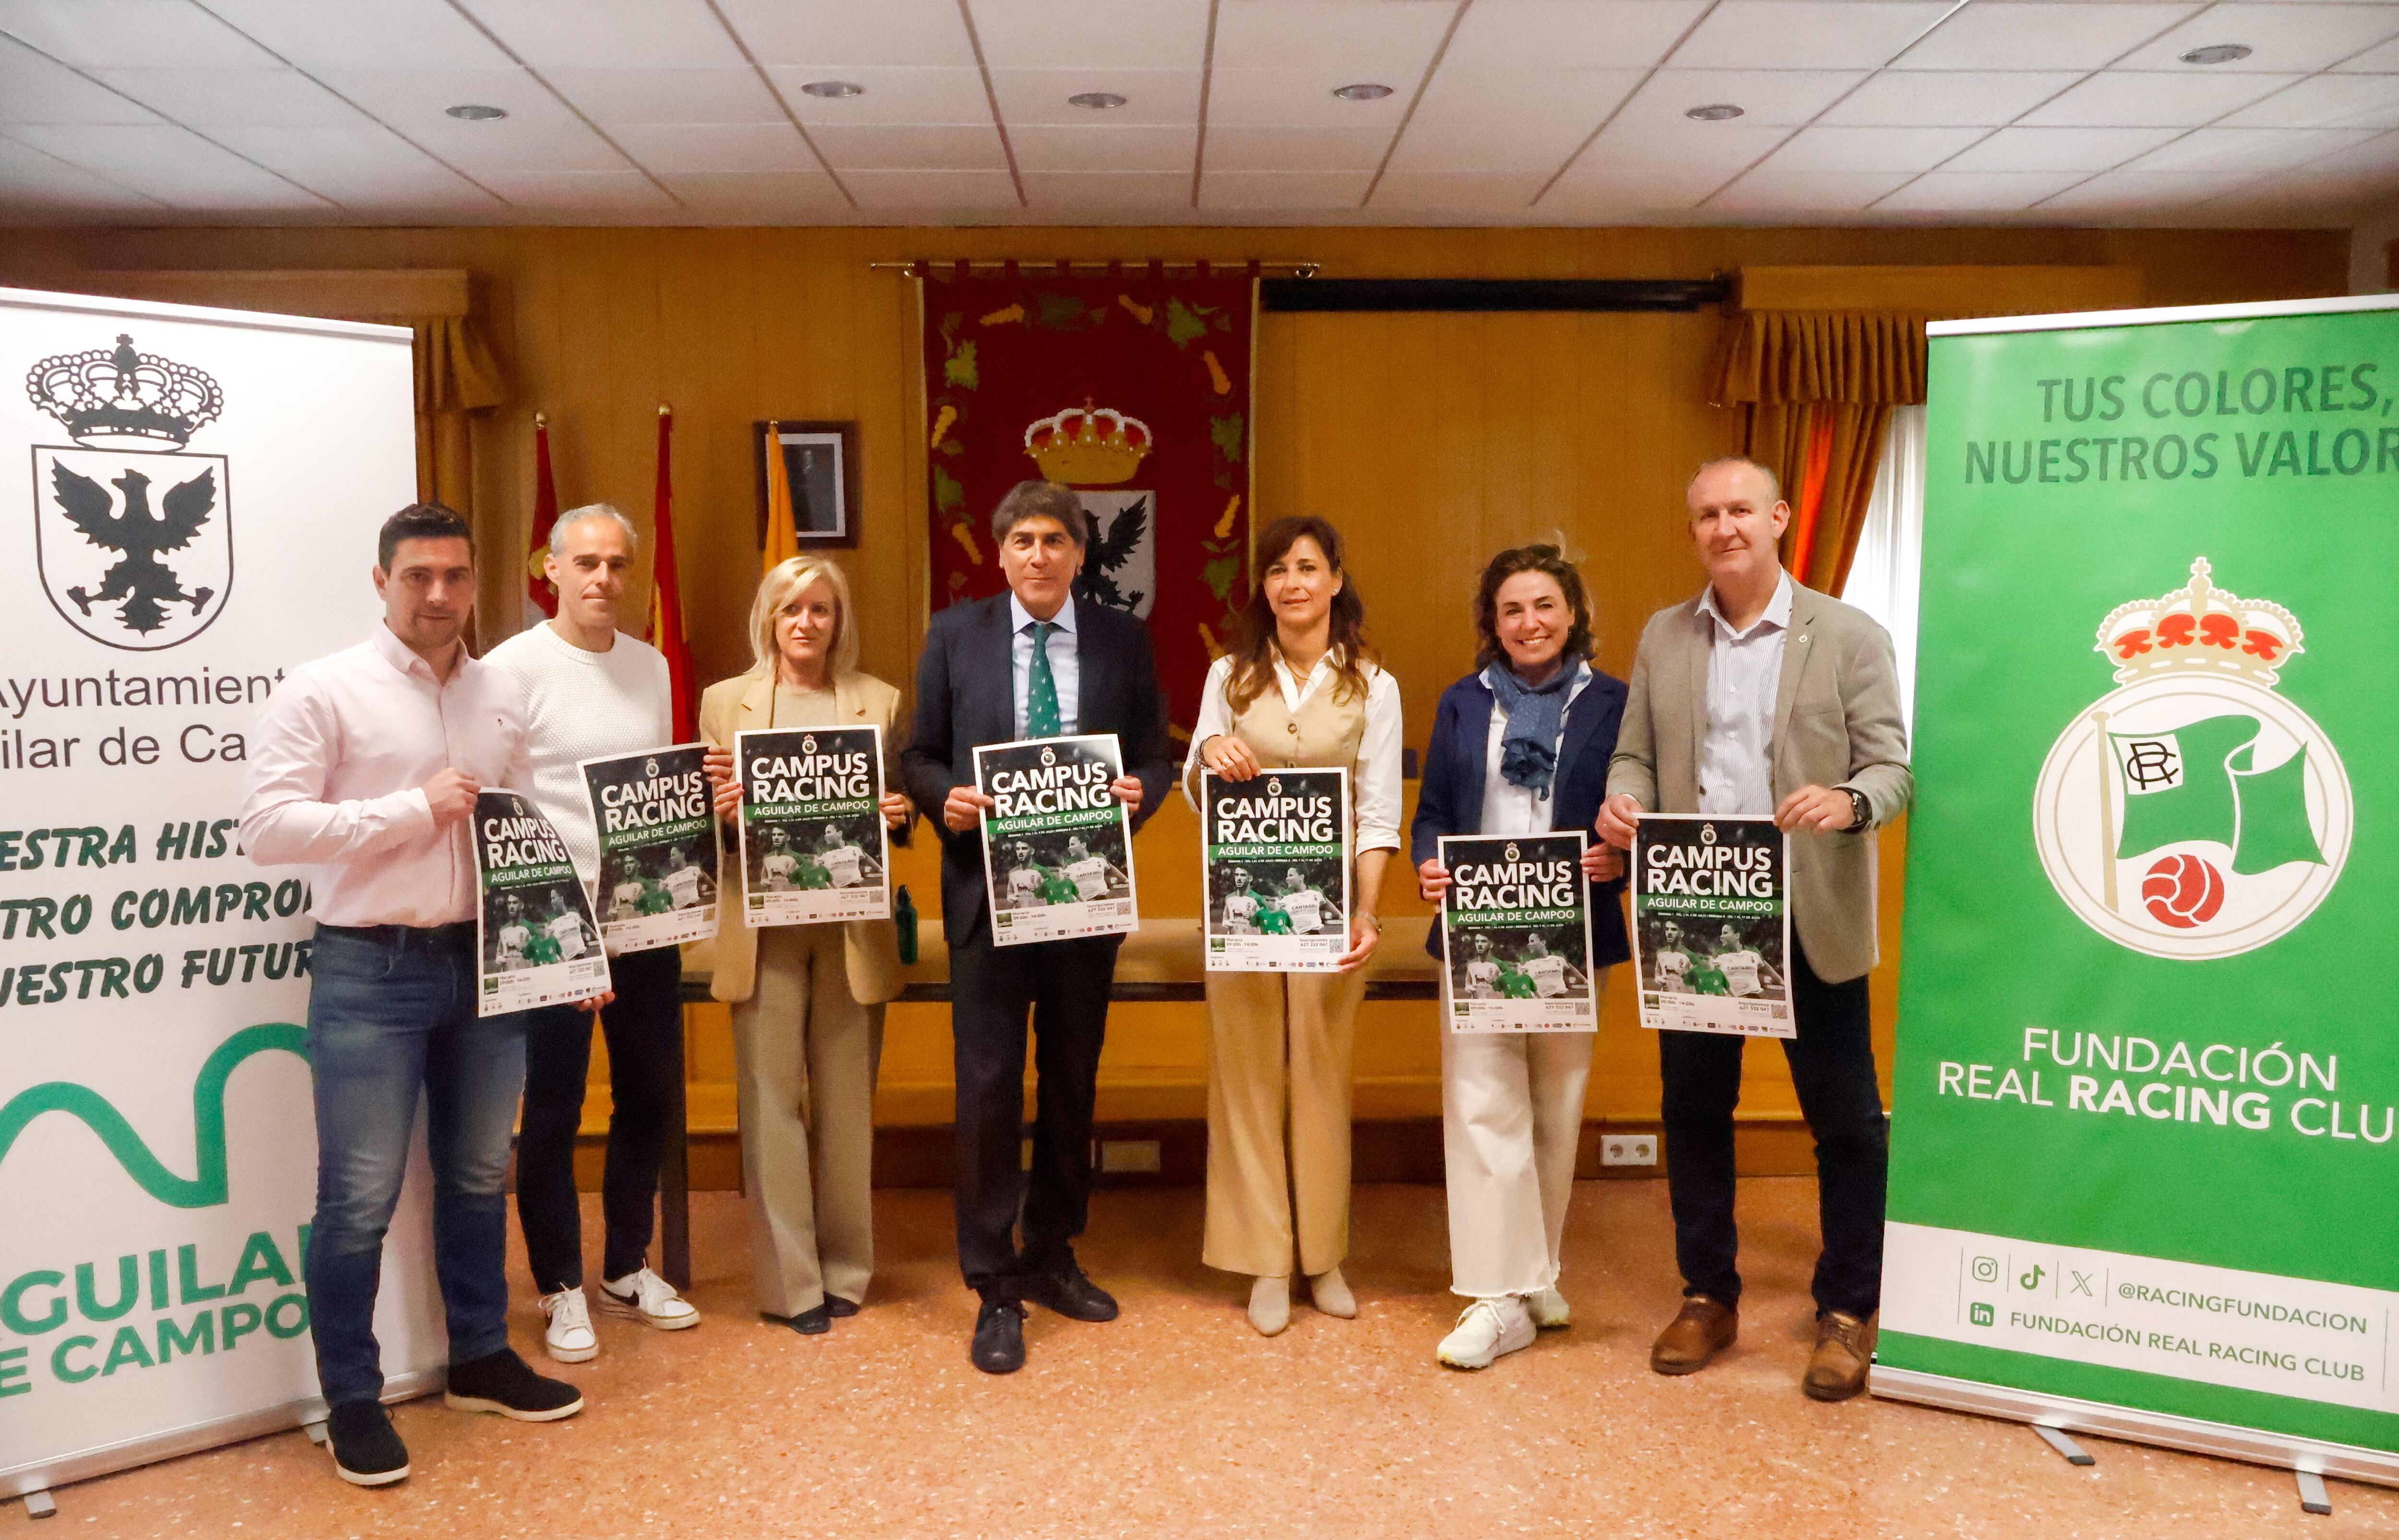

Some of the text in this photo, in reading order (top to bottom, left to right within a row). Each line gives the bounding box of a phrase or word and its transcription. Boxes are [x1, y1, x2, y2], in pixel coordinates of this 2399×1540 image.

[2037, 363, 2393, 422] TUS COLORES,
[1964, 432, 2219, 485] NUESTROS
[99, 726, 160, 766] de
[751, 753, 868, 780] CAMPUS
[992, 762, 1108, 794] CAMPUS
[601, 771, 703, 808] CAMPUS
[752, 775, 869, 804] RACING
[994, 784, 1112, 818] RACING
[605, 793, 705, 833] RACING
[754, 800, 870, 816] AGUILAR DE CAMPOO
[997, 810, 1113, 831] AGUILAR DE CAMPOO
[1217, 796, 1332, 819] CAMPUS
[156, 818, 245, 860] HIS
[484, 817, 557, 842] CAMPUS
[608, 829, 649, 846] AGUILAR
[651, 828, 664, 838] DE
[666, 818, 707, 835] CAMPOO
[1218, 818, 1333, 843] RACING
[487, 838, 567, 869] RACING
[1218, 845, 1333, 856] AGUILAR DE CAMPOO
[1647, 844, 1772, 871] CAMPUS
[491, 865, 572, 883] AGUILAR DE CAMPOO
[1454, 861, 1572, 886] CAMPUS
[1647, 869, 1773, 898] RACING
[111, 878, 312, 931] COMPRO
[1456, 883, 1574, 910] RACING
[1647, 898, 1773, 912] AGUILAR DE CAMPOO
[1457, 910, 1575, 923] AGUILAR DE CAMPOO
[2023, 1027, 2336, 1091] FUNDACIÓN
[1938, 1061, 2053, 1107] REAL
[2069, 1075, 2271, 1129] RACING
[2118, 1281, 2367, 1334] @RACINGFUNDACION
[2010, 1311, 2141, 1346] FUNDACIÓN
[2148, 1332, 2202, 1357] REAL
[2208, 1345, 2297, 1372] RACING
[2304, 1358, 2365, 1382] CLUB
